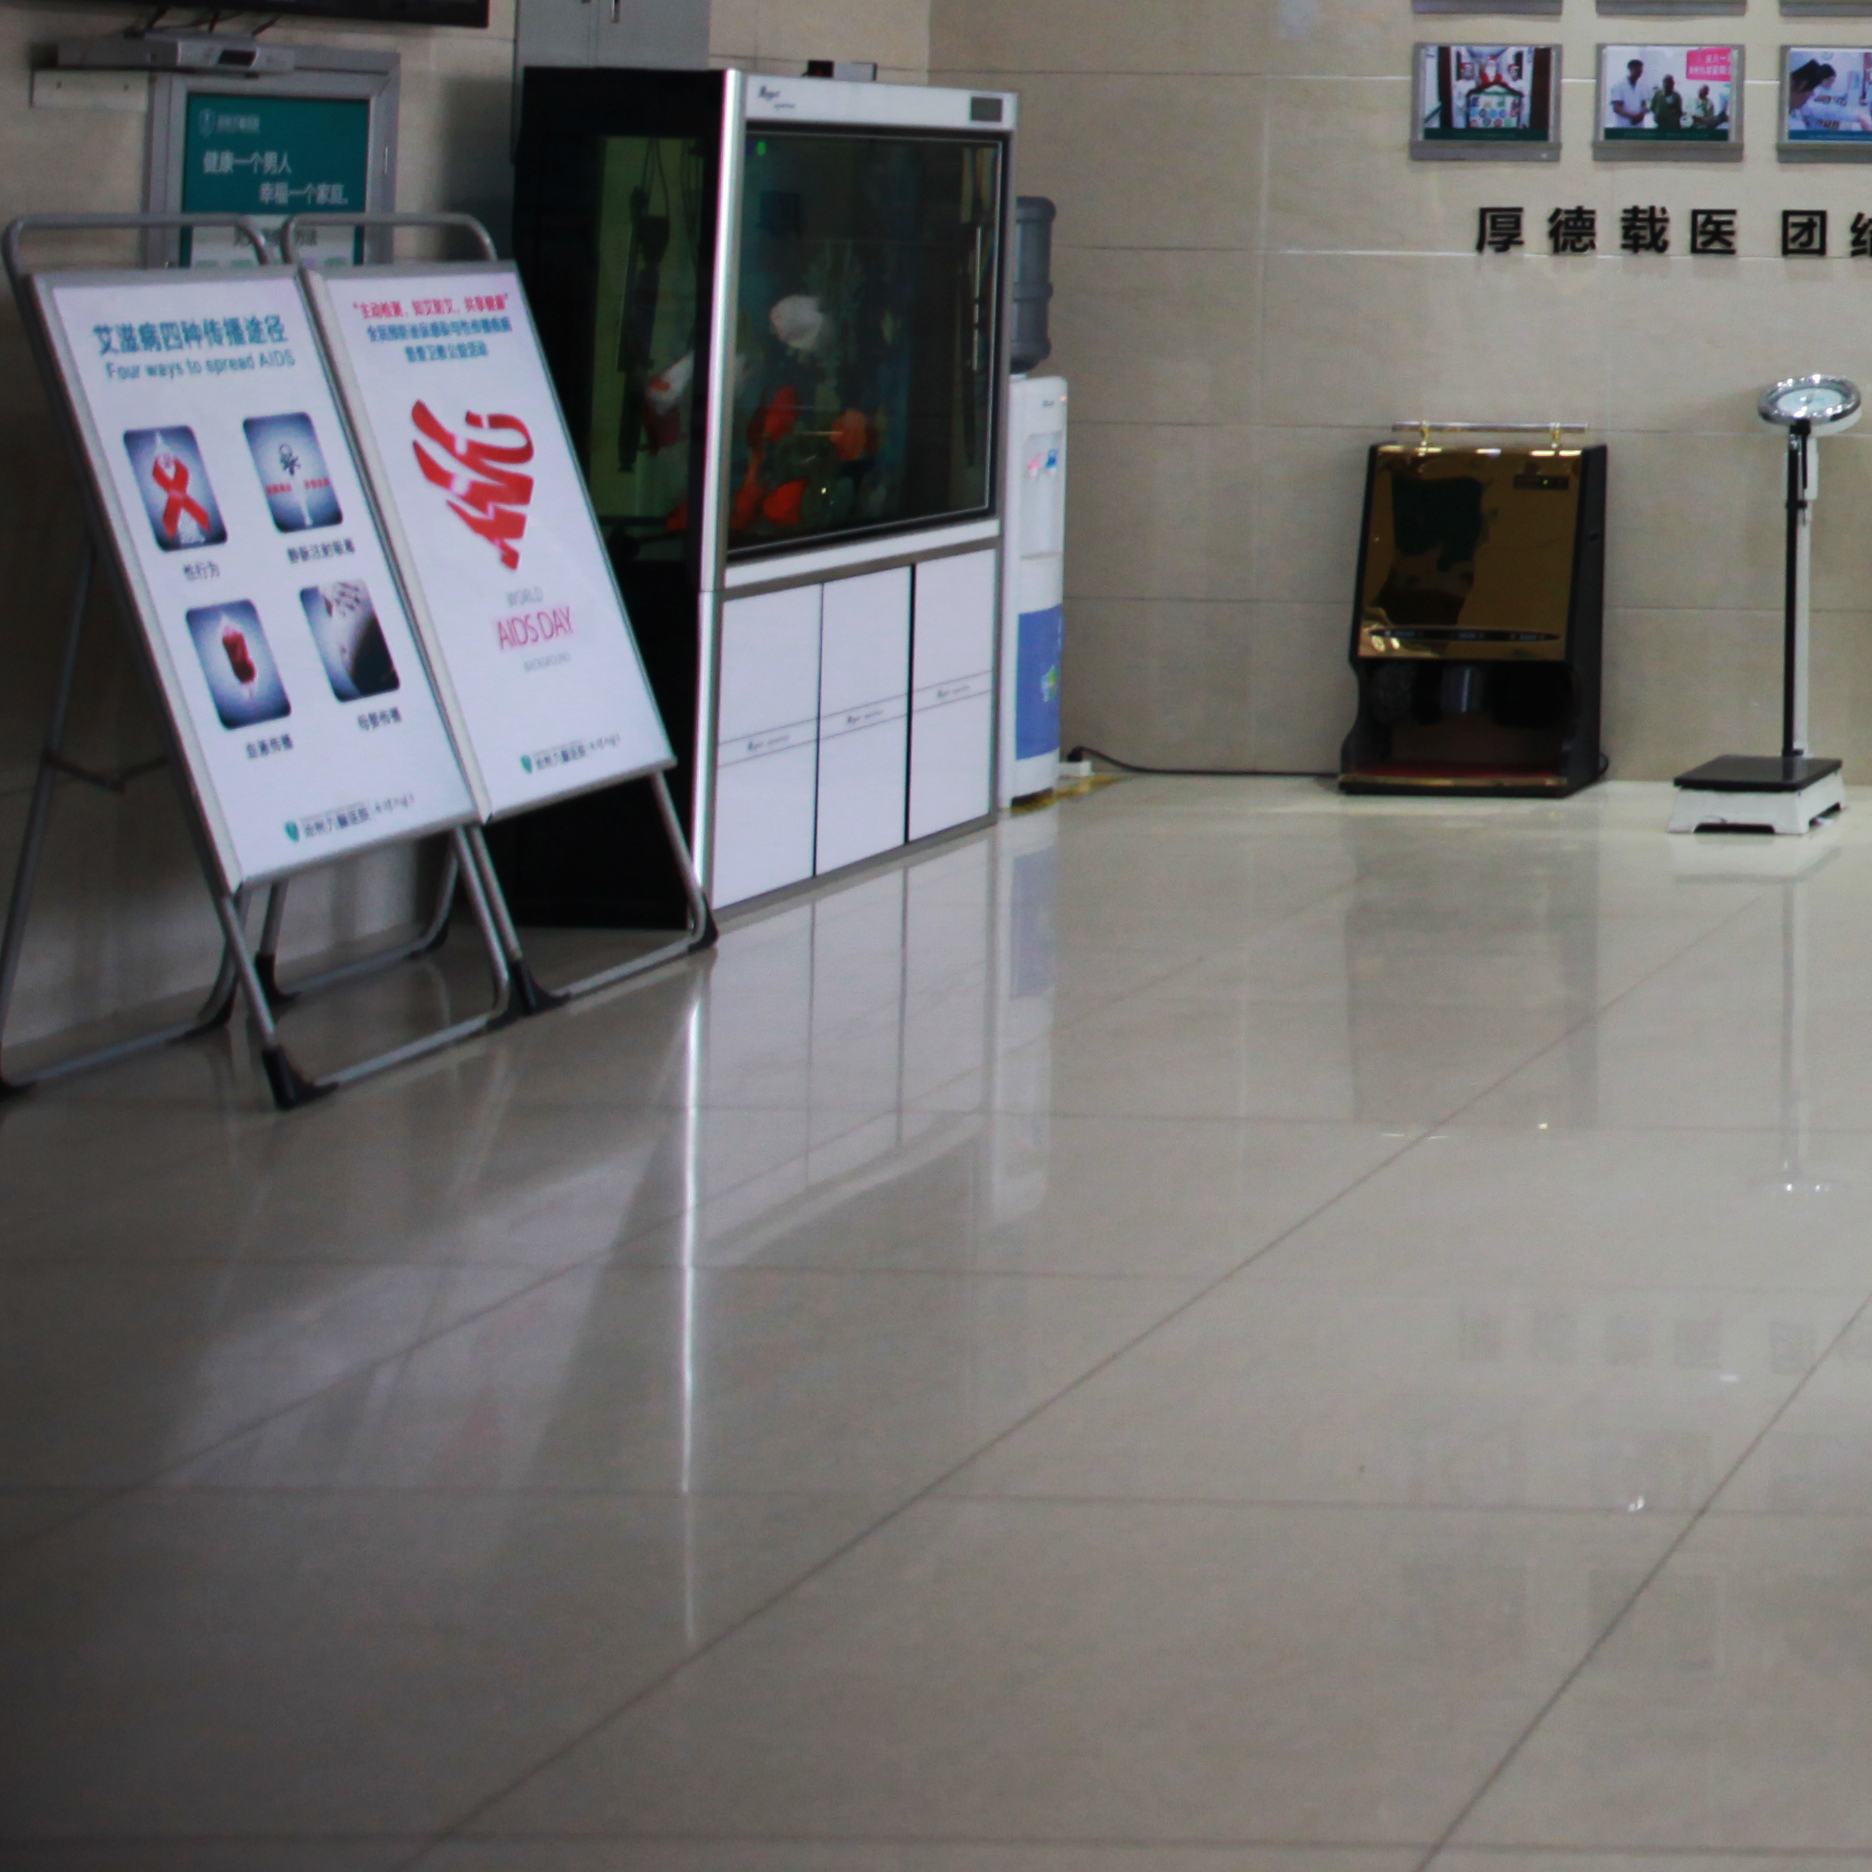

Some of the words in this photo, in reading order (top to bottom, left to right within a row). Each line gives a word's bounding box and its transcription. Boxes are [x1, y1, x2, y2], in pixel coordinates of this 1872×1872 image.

[106, 361, 140, 378] Four
[146, 359, 183, 379] ways
[187, 358, 202, 374] to
[205, 354, 254, 375] spread
[258, 349, 296, 368] AIDS
